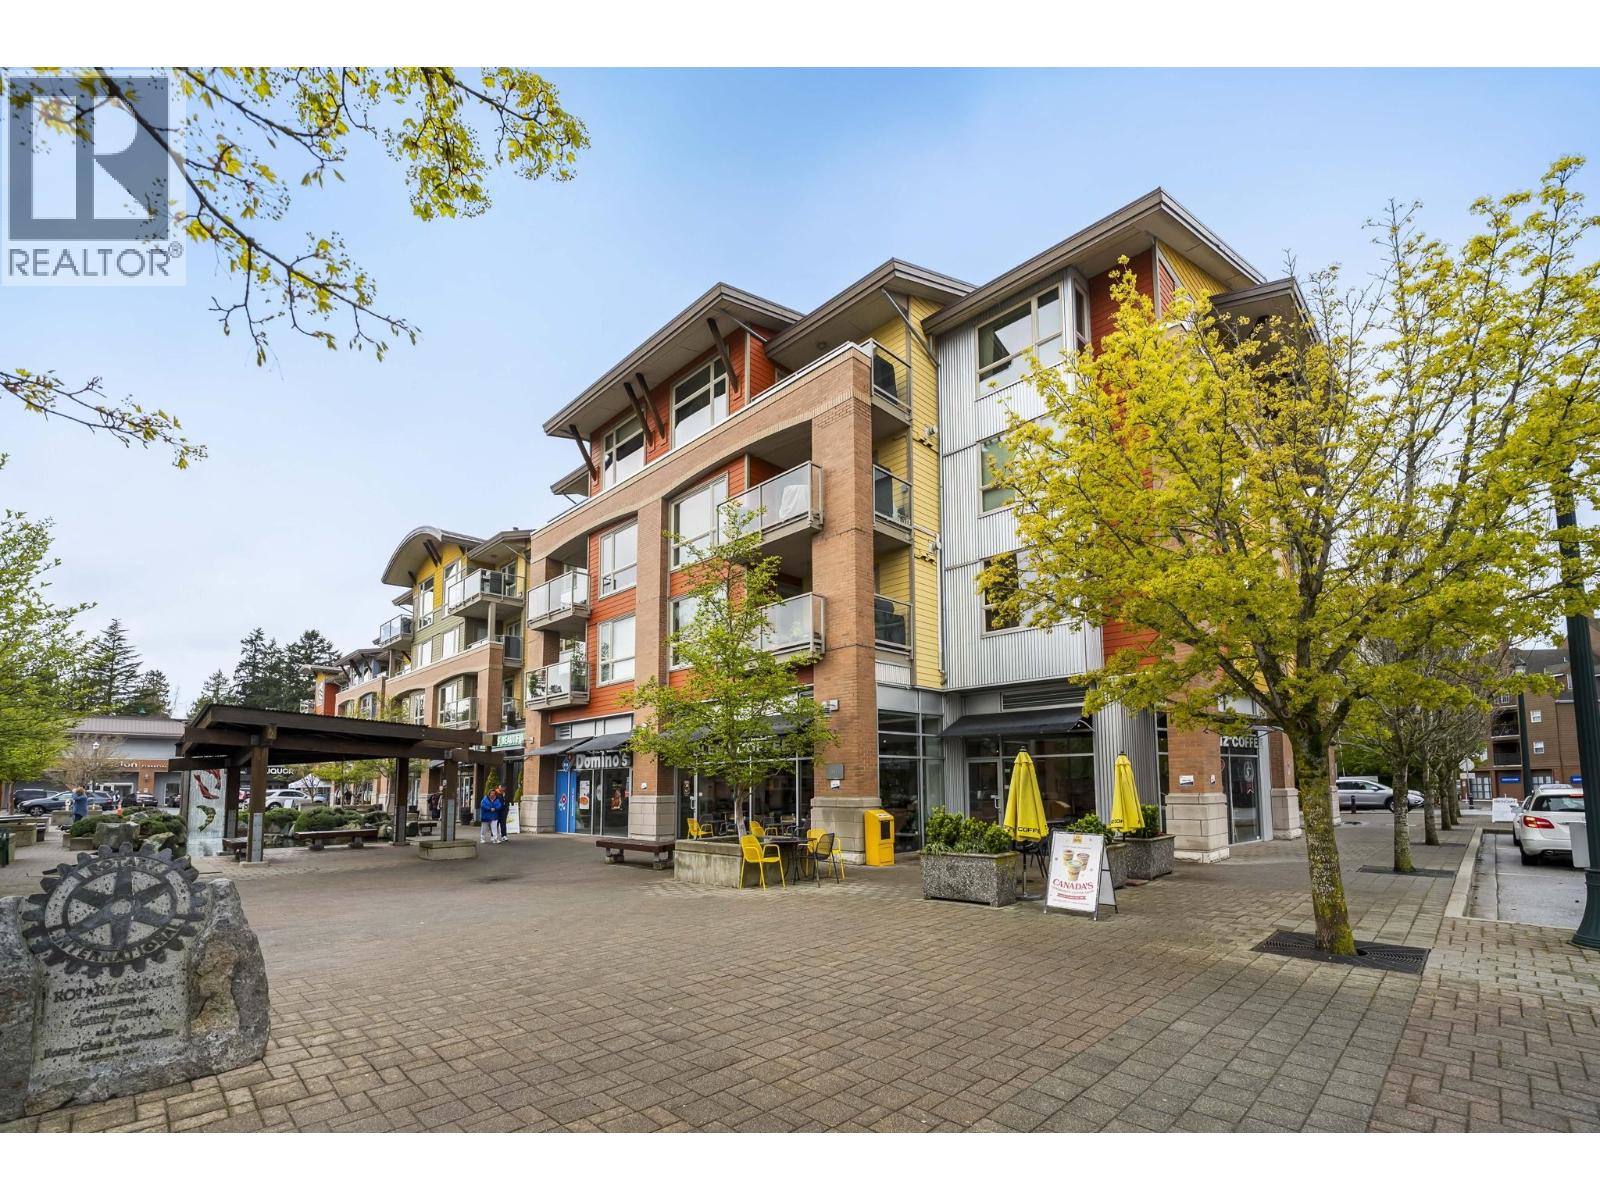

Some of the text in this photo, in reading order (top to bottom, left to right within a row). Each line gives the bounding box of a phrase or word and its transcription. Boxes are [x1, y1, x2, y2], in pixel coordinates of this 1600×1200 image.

[1232, 736, 1258, 748] COFFE
[576, 752, 629, 769] Domino's
[266, 767, 295, 775] IQUOR
[1052, 878, 1094, 890] CANADA'S
[47, 926, 183, 962] INTERNATIONAL
[53, 981, 117, 1003] ROTARY
